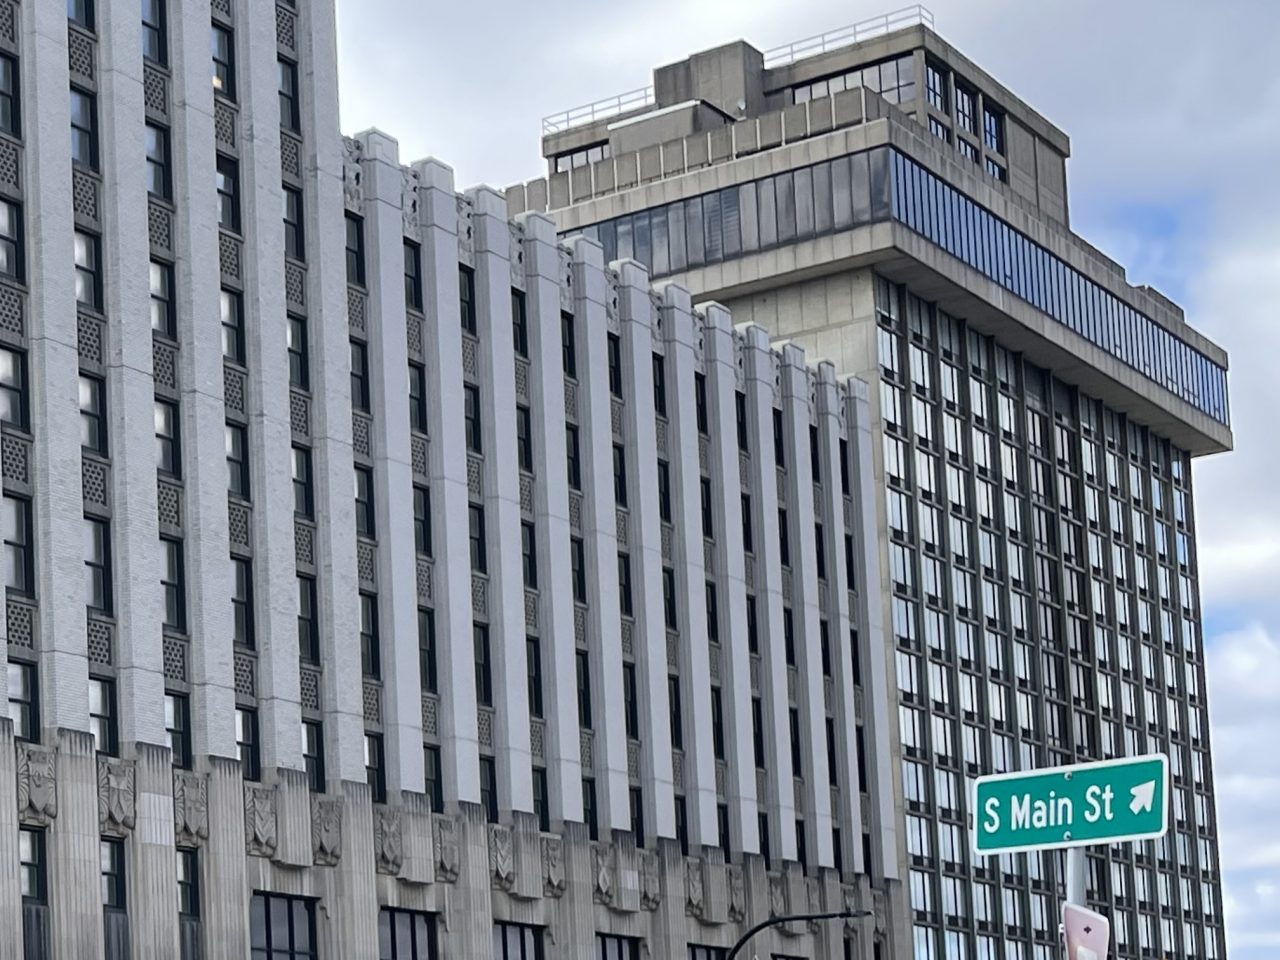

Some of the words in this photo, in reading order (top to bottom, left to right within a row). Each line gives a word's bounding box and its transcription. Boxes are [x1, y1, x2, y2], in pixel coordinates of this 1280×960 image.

[983, 796, 1000, 833] S
[1011, 790, 1073, 831] Main
[1084, 784, 1114, 823] St
